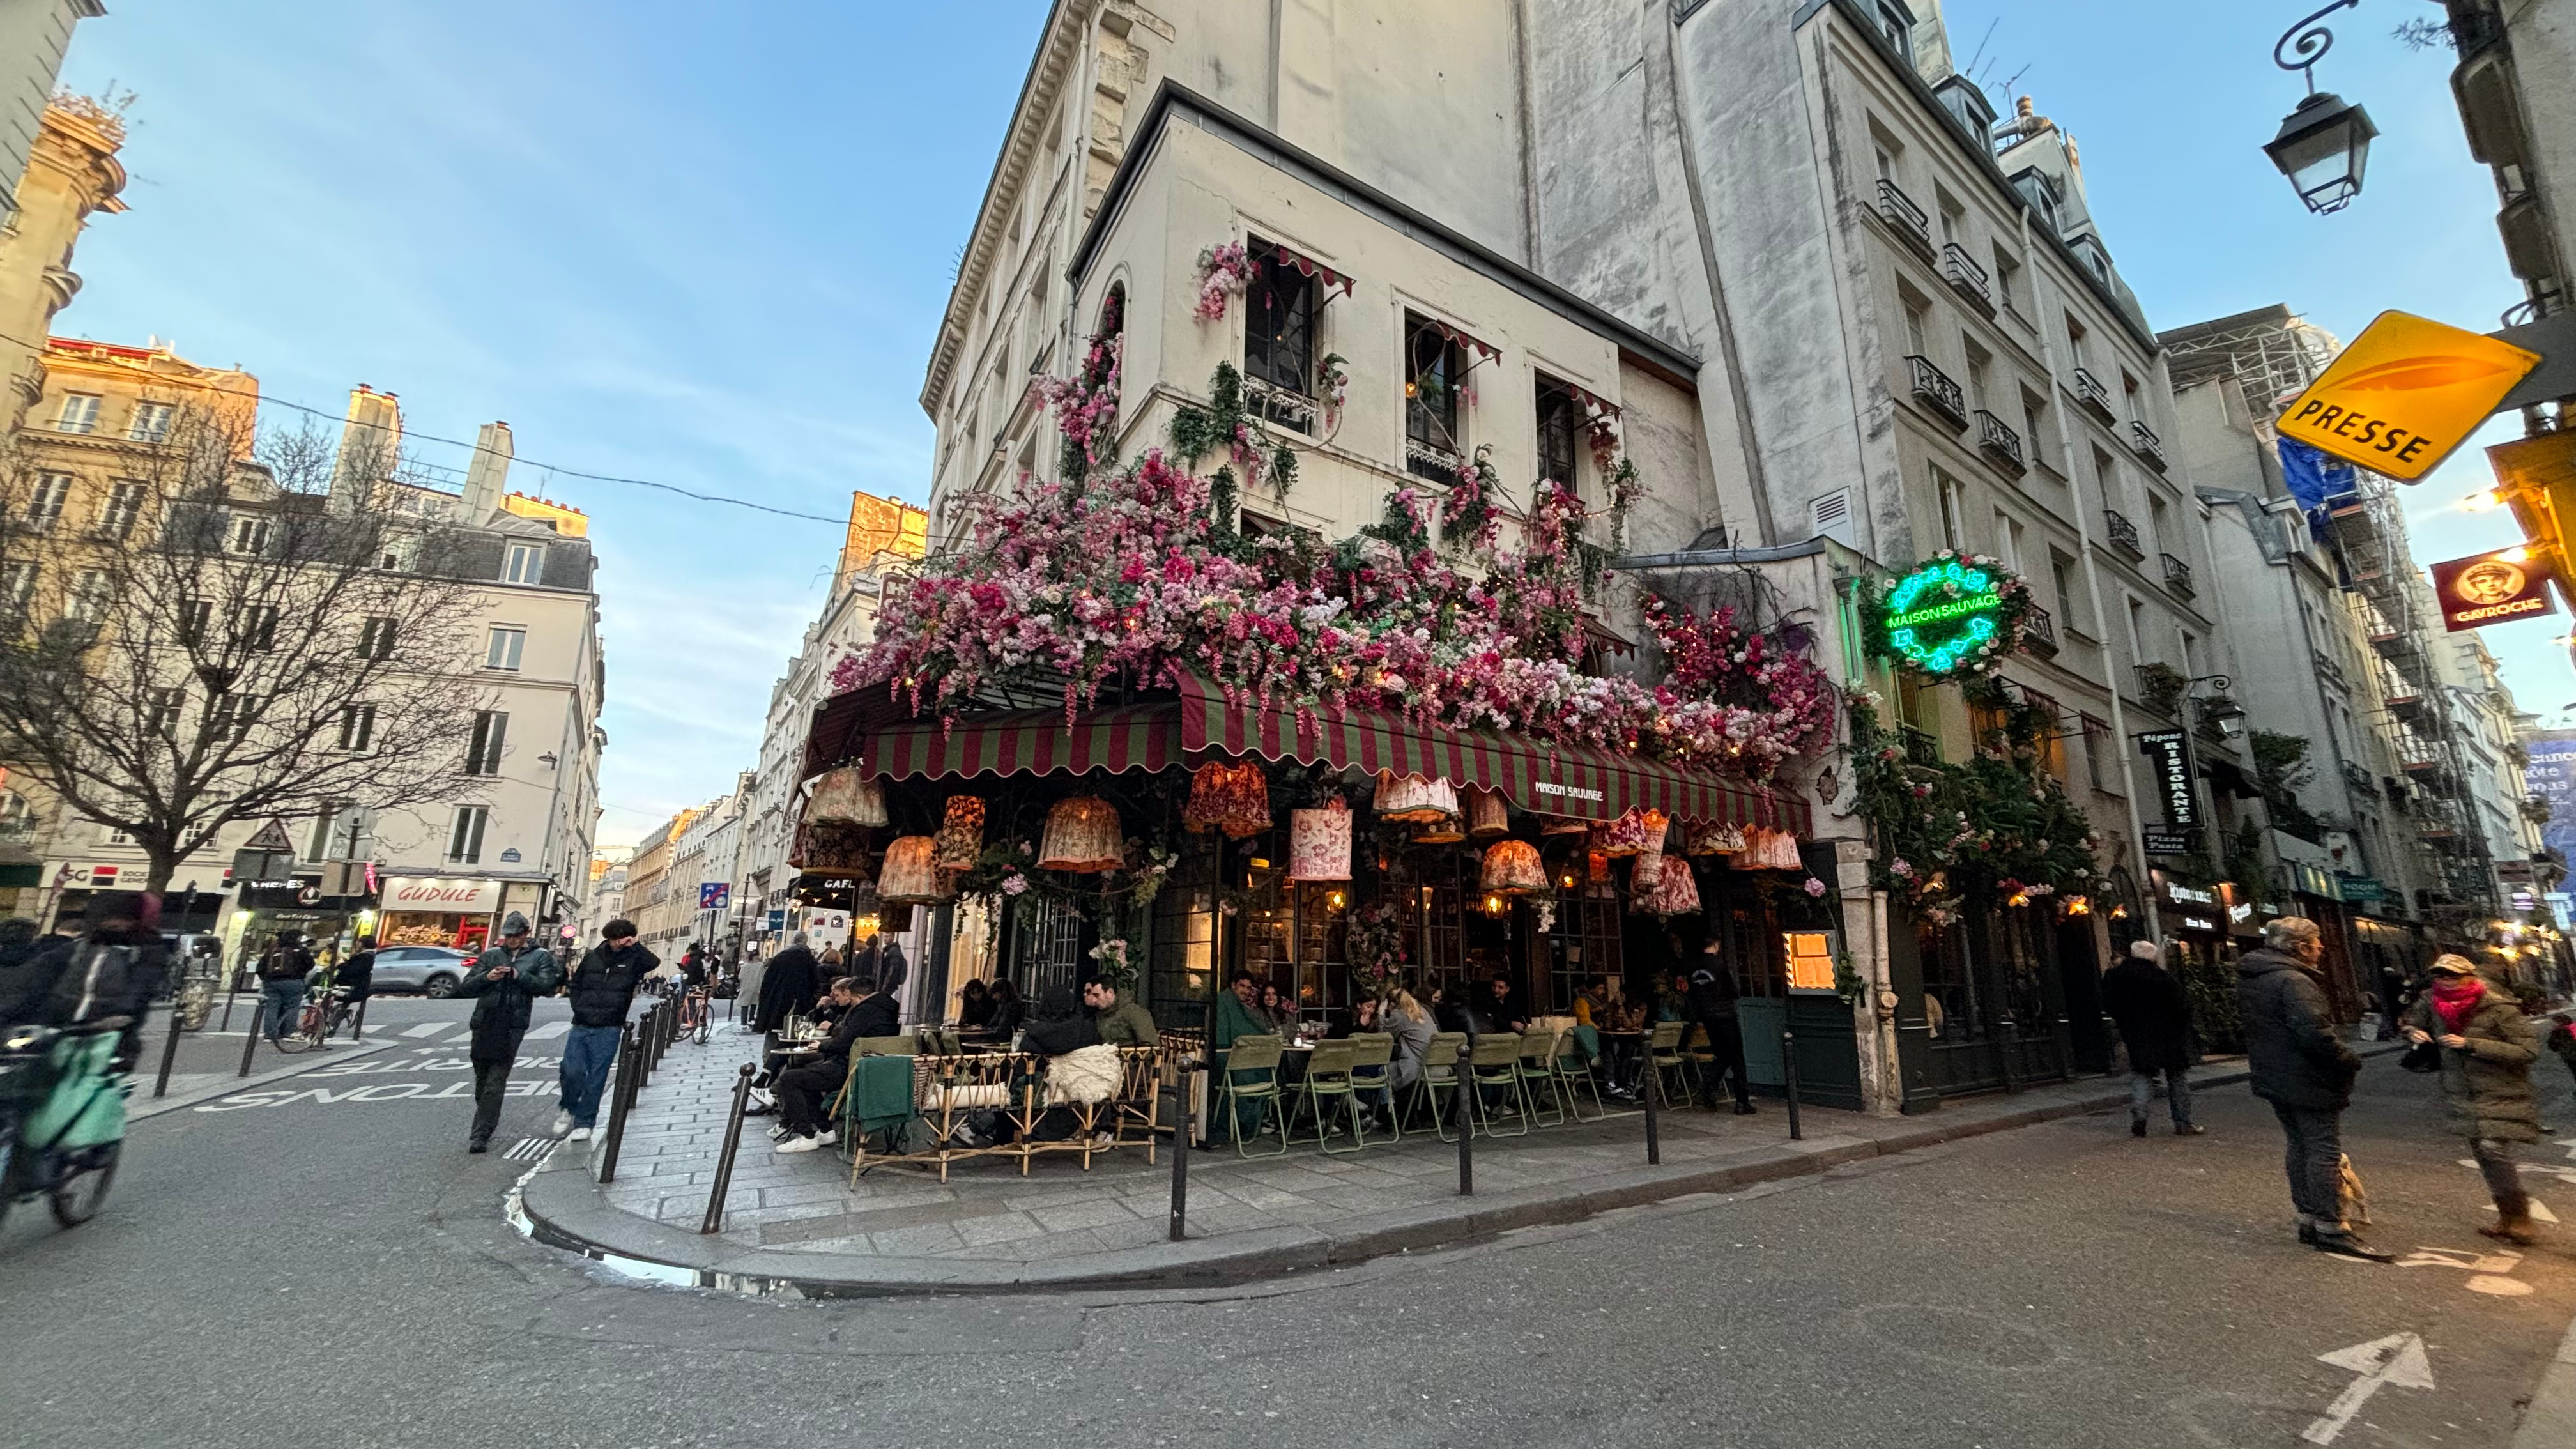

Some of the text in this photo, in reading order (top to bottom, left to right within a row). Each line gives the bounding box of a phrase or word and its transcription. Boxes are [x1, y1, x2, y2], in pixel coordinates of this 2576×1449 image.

[2294, 399, 2432, 463] PRESSE
[1888, 594, 2002, 629] MAISON SAUVAGE
[2456, 597, 2543, 622] GAVROCHE
[2142, 733, 2182, 743] Pépone
[1535, 781, 1604, 802] MAISON SAUVAGE
[2163, 742, 2192, 823] RISTORANTE
[397, 885, 481, 902] GUDULE
[194, 1080, 563, 1112] IETONS
